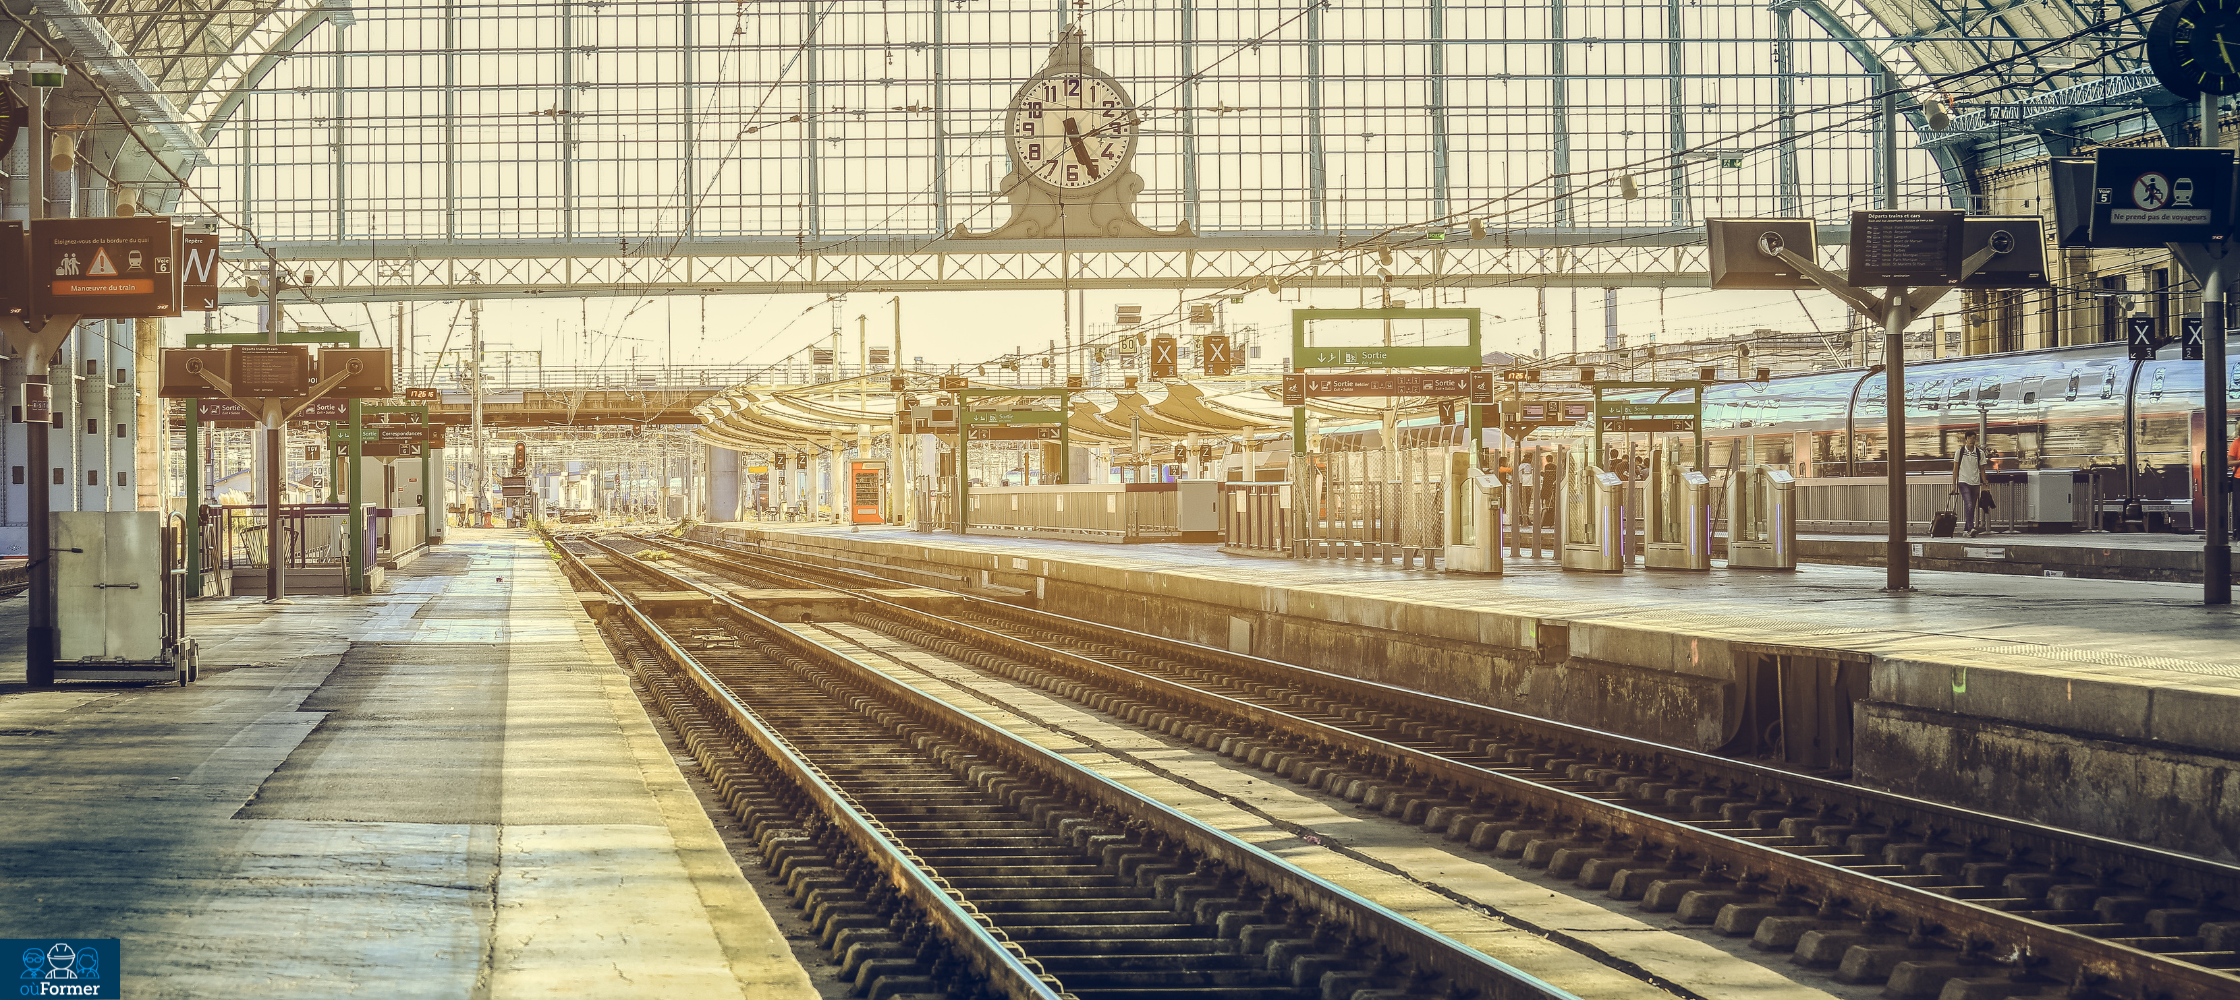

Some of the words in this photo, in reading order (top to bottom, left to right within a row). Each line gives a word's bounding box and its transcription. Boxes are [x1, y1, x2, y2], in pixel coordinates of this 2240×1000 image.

[1044, 85, 1057, 103] 11
[1063, 79, 1080, 97] 12
[1090, 85, 1096, 103] 1
[1027, 101, 1042, 119] 10
[1103, 100, 1115, 118] 2
[1022, 122, 1035, 139] 9
[1109, 121, 1121, 139] 3
[1028, 143, 1041, 161] 8
[1100, 143, 1115, 161] 4
[1046, 159, 1059, 178] 7
[1066, 164, 1079, 182] 6
[2101, 193, 2108, 203] 5
[2125, 213, 2147, 222] prend
[2171, 214, 2207, 222] voyageurs
[184, 237, 204, 245] Repère
[159, 263, 167, 272] 6
[71, 284, 107, 292] Manœuvre
[108, 284, 118, 292] du
[118, 284, 136, 292] train
[2134, 325, 2150, 345] X
[2188, 325, 2203, 345] X
[1121, 339, 1134, 349] 60
[1156, 345, 1172, 364] X
[1210, 343, 1226, 362] X
[1361, 351, 1387, 359] Sortie
[316, 403, 335, 411] Sortie
[1442, 404, 1451, 417] Y
[310, 452, 314, 460] 1
[799, 456, 806, 464] Z
[1177, 448, 1184, 457] Z
[1202, 448, 1209, 457] Z
[777, 456, 784, 465] Z
[313, 467, 323, 476] 30
